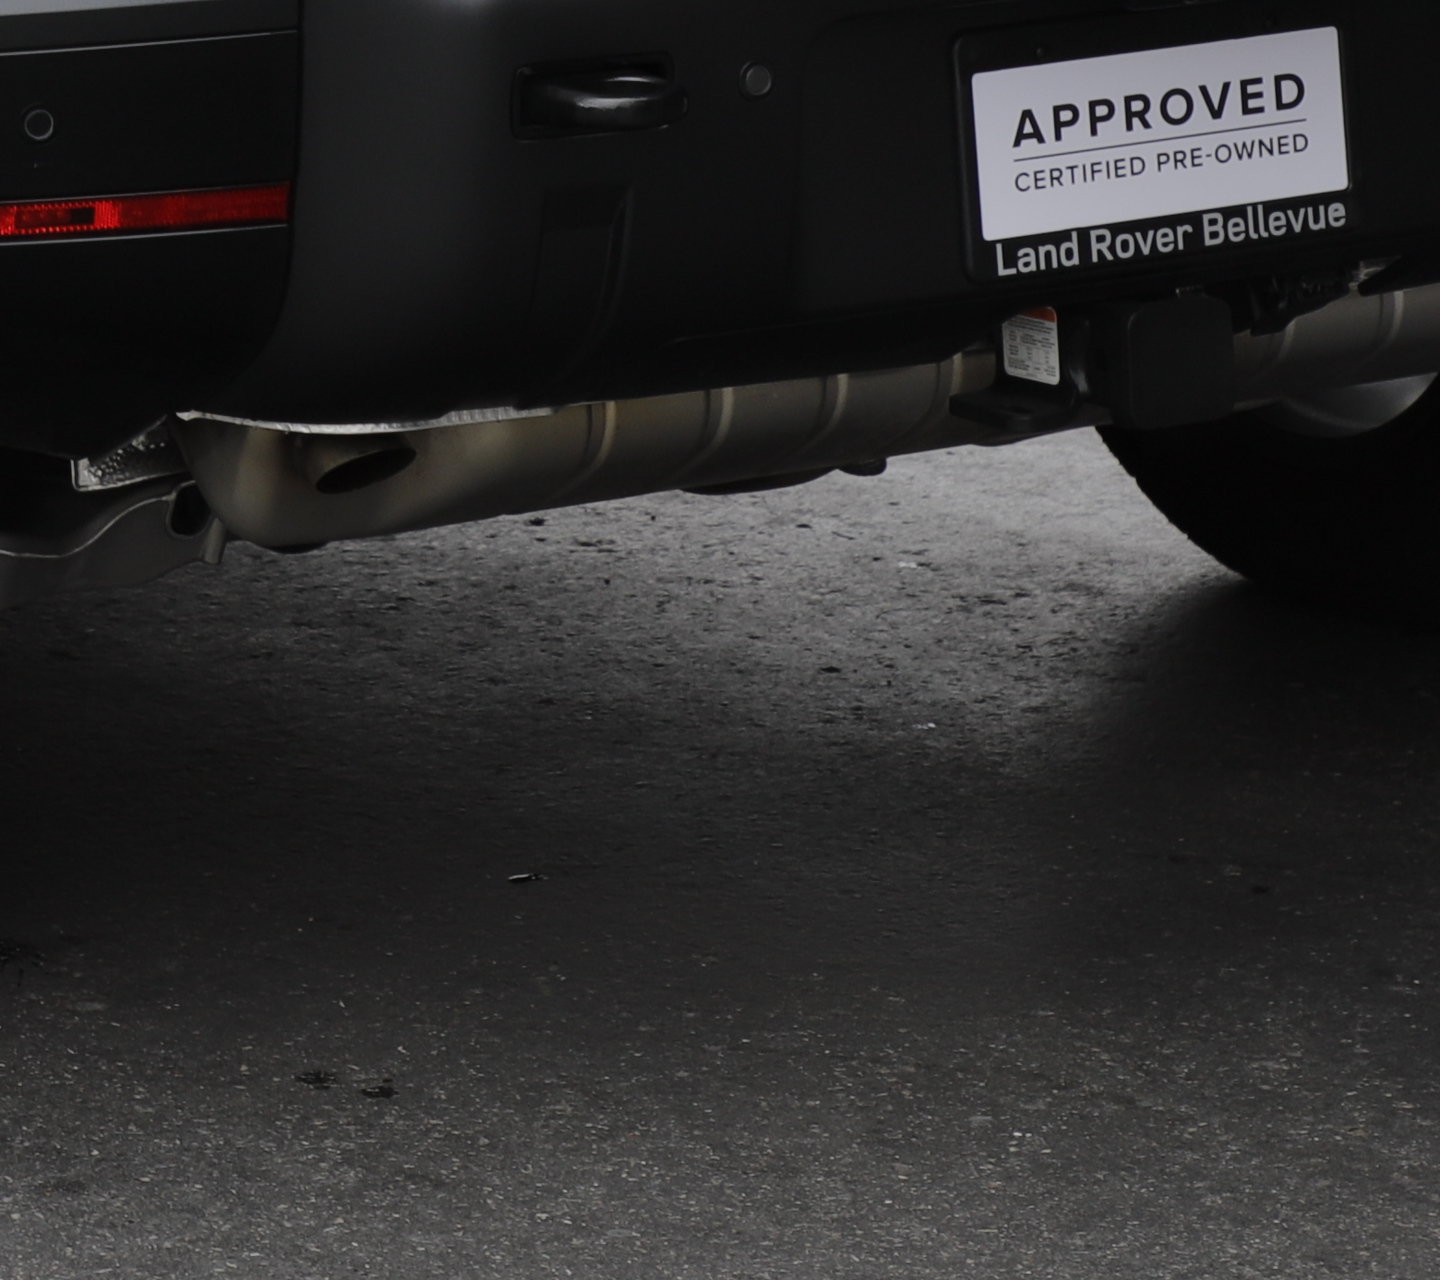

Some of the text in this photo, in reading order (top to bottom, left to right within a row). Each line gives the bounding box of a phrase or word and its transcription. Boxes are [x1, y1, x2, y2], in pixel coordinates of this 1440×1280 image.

[1012, 73, 1306, 148] APPROVED
[1014, 133, 1310, 193] CERTIFIED PRE-OWNED
[995, 201, 1347, 277] Land Rover Bellevue
